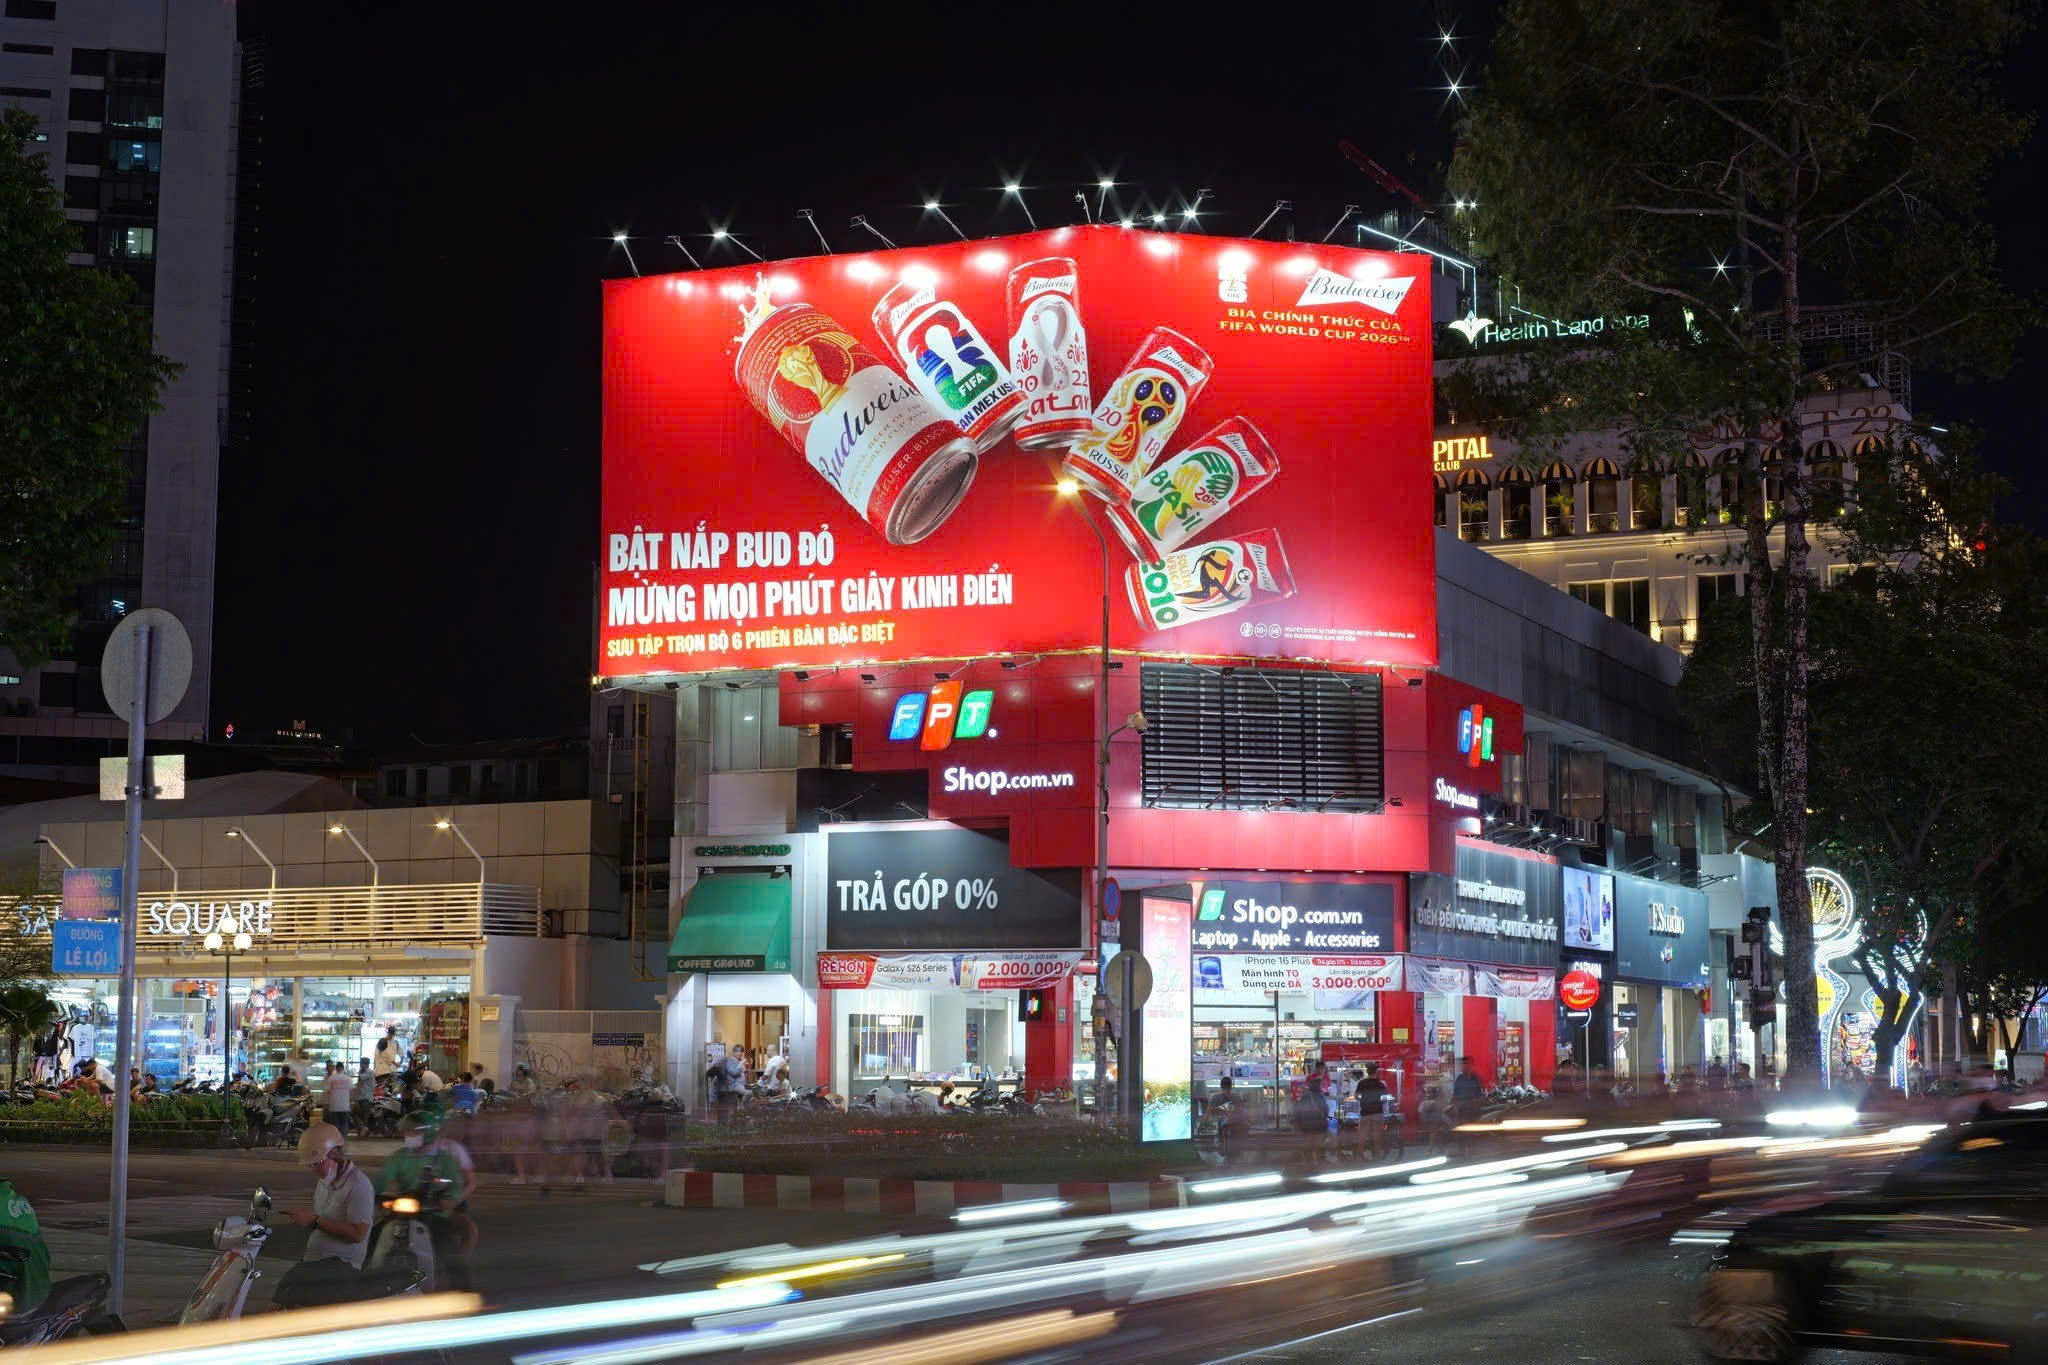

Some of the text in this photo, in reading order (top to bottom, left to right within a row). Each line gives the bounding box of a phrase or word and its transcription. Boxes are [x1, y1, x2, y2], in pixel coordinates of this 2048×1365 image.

[1305, 275, 1406, 301] Budweiser
[1220, 321, 1255, 332] FIFA
[1259, 323, 1320, 337] WORLD
[1324, 329, 1356, 340] CUP
[1228, 308, 1401, 331] BIA CHÍNH THỨC CỦA
[1485, 322, 1548, 344] Health
[1556, 316, 1604, 338] Land
[1157, 347, 1198, 381] Budweiser
[958, 372, 988, 399] FIFA
[1072, 370, 1089, 388] 22
[975, 389, 998, 416] MEX
[1097, 406, 1161, 458] 20 18
[1088, 449, 1129, 482] RUSSIA
[1225, 431, 1258, 476] Budweiser
[1434, 460, 1461, 472] CLUB
[1193, 486, 1219, 507] 2014
[609, 520, 834, 579] BẬT NẮP BUD ĐỎ
[1250, 541, 1272, 591] Budweiser
[608, 563, 1013, 627] MỪNG MỌI PHÚT GIÂY KINH ĐIỂN
[1141, 558, 1180, 624] 2010
[607, 620, 895, 658] SƯU TẬP TRỌN BỘ 6 PHIÊN BẢN ĐẶC BIỆT
[944, 766, 1075, 796] Shop.com.vn
[836, 870, 998, 911] TRẢ GÓP 0%
[149, 901, 275, 935] SQUARE
[70, 925, 104, 941] ĐƯỜNG
[1252, 929, 1290, 951] Apple
[1304, 931, 1380, 948] Accessories
[65, 946, 108, 971] LÊ LỢI
[677, 959, 755, 969] COFFEE GROUND
[876, 963, 948, 975] Galaxy S26 Series
[1244, 956, 1311, 965] iPhone 16 Plus
[891, 976, 917, 985] Galaxy
[1241, 968, 1299, 977] Màn hình TO
